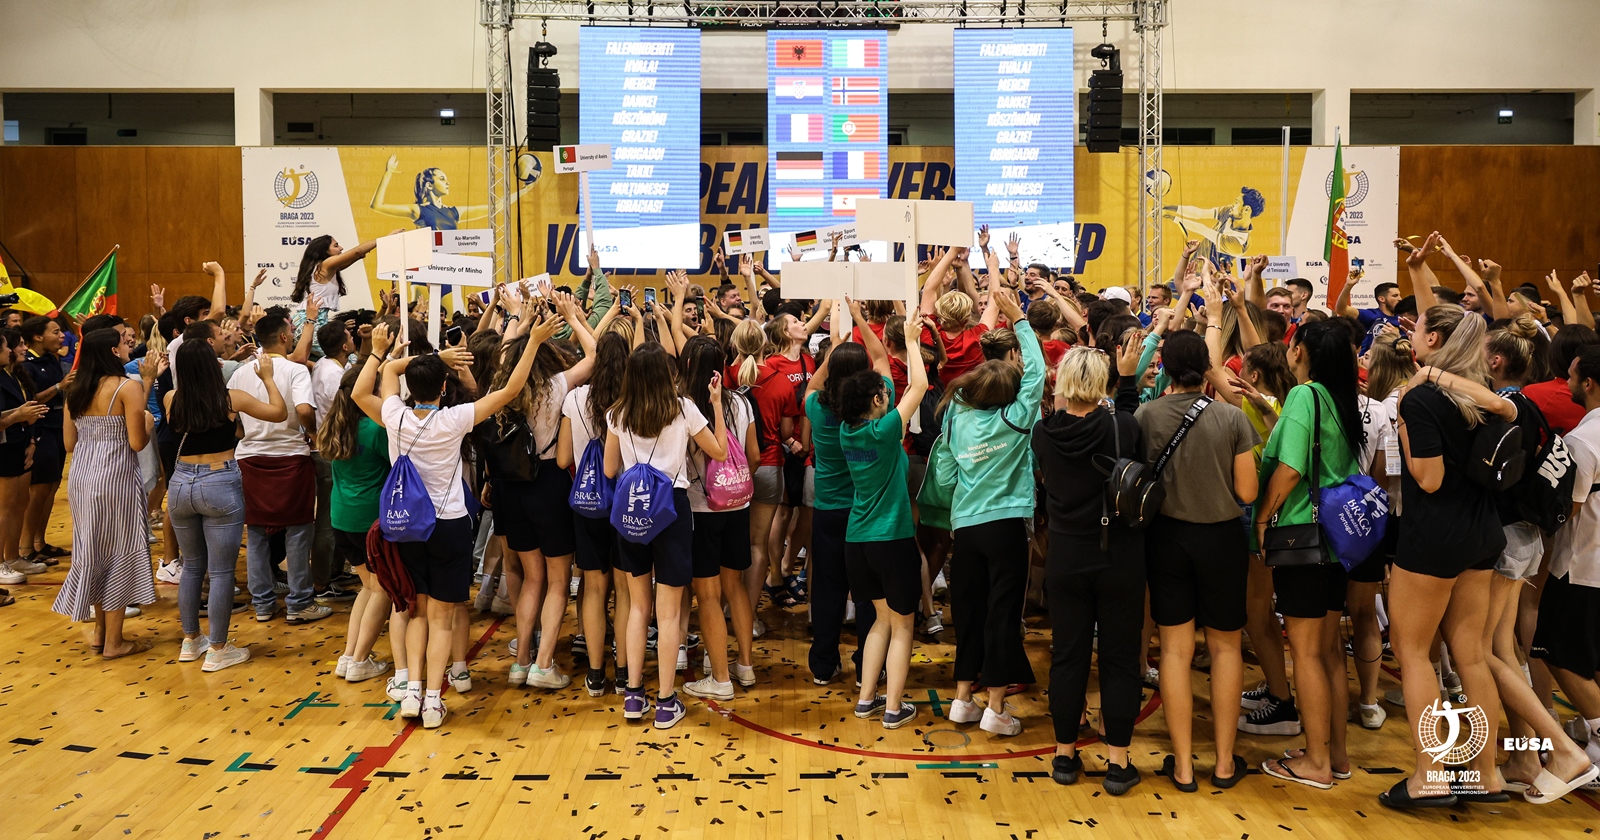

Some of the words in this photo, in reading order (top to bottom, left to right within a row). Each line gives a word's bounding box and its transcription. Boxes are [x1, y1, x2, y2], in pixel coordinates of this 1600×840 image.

[622, 95, 658, 108] DANKE!
[996, 96, 1032, 108] DANKE!
[622, 130, 658, 142] GRAZIE!
[996, 130, 1032, 143] GRAZIE!
[626, 165, 654, 178] TAKK!
[1002, 166, 1028, 178] TAKK!
[280, 212, 298, 220] BRAGA
[282, 236, 312, 246] EUSA
[1346, 236, 1362, 244] SA
[1171, 427, 1186, 446] SWOOSH
[574, 490, 601, 500] BRAGA
[622, 514, 654, 526] BRAGA
[1347, 499, 1372, 536] BRAGA
[1338, 513, 1354, 535] Portugal
